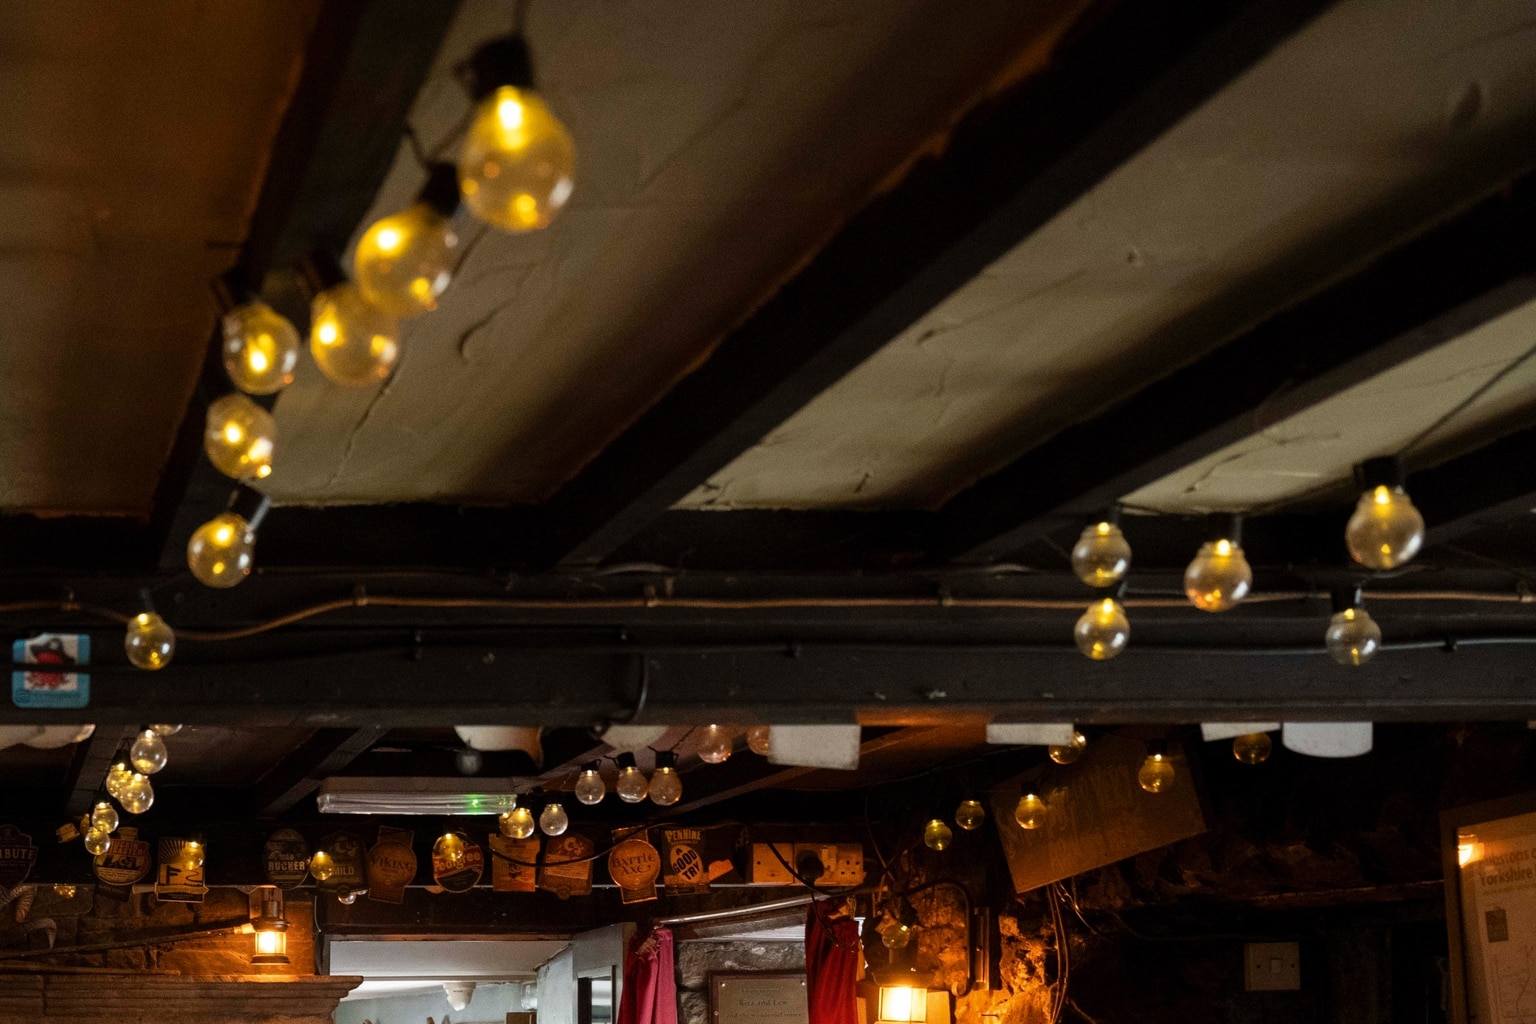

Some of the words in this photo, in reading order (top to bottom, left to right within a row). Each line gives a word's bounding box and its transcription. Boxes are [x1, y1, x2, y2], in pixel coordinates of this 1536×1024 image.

[663, 829, 703, 842] PENNINE
[675, 847, 683, 856] A
[267, 860, 306, 872] RUCKER
[612, 852, 655, 868] BATTLE
[672, 849, 698, 874] GOOD
[682, 862, 701, 881] TRY
